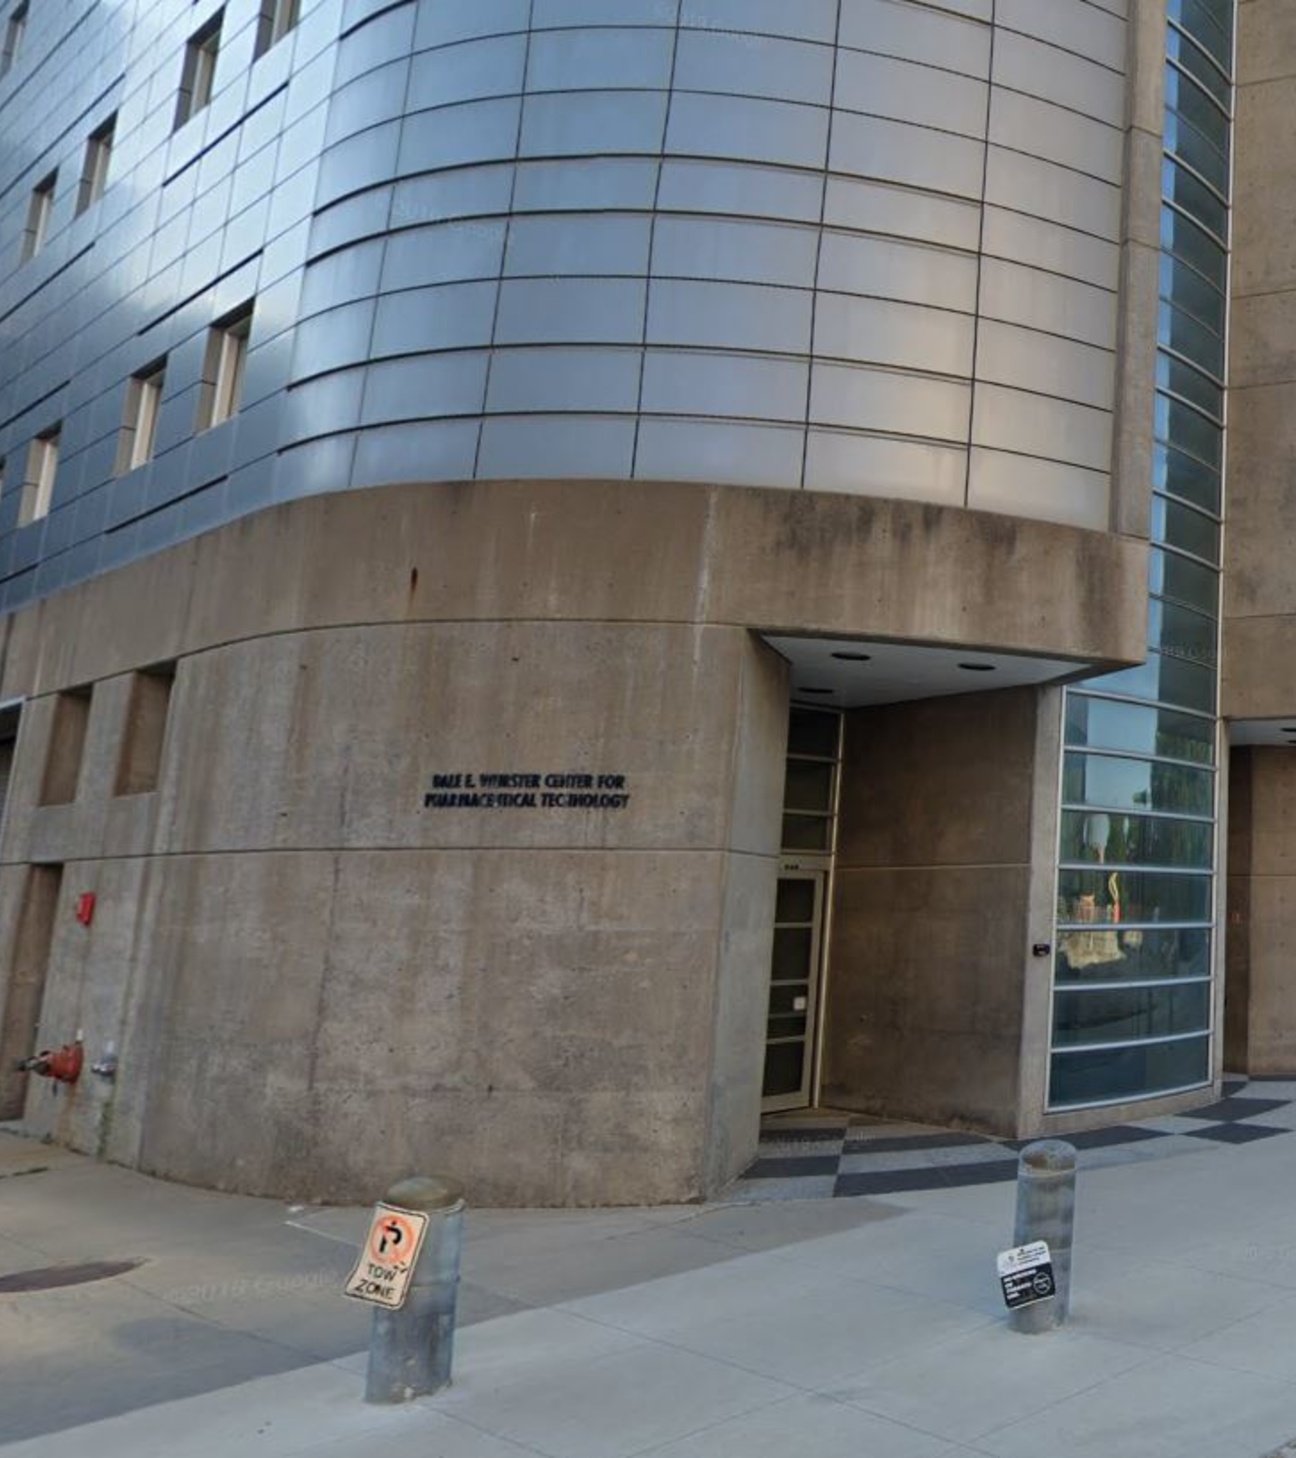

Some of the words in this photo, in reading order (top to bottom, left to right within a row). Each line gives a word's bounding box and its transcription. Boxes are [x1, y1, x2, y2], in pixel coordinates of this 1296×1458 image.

[432, 774, 463, 789] DALE
[464, 774, 476, 789] E.
[544, 774, 593, 789] CENTER
[597, 774, 626, 789] FOR
[424, 793, 537, 808] PHARMACEUTICAL
[540, 793, 630, 808] TECHNOLOGY
[367, 1263, 397, 1281] TOW
[354, 1278, 396, 1300] ZONE
